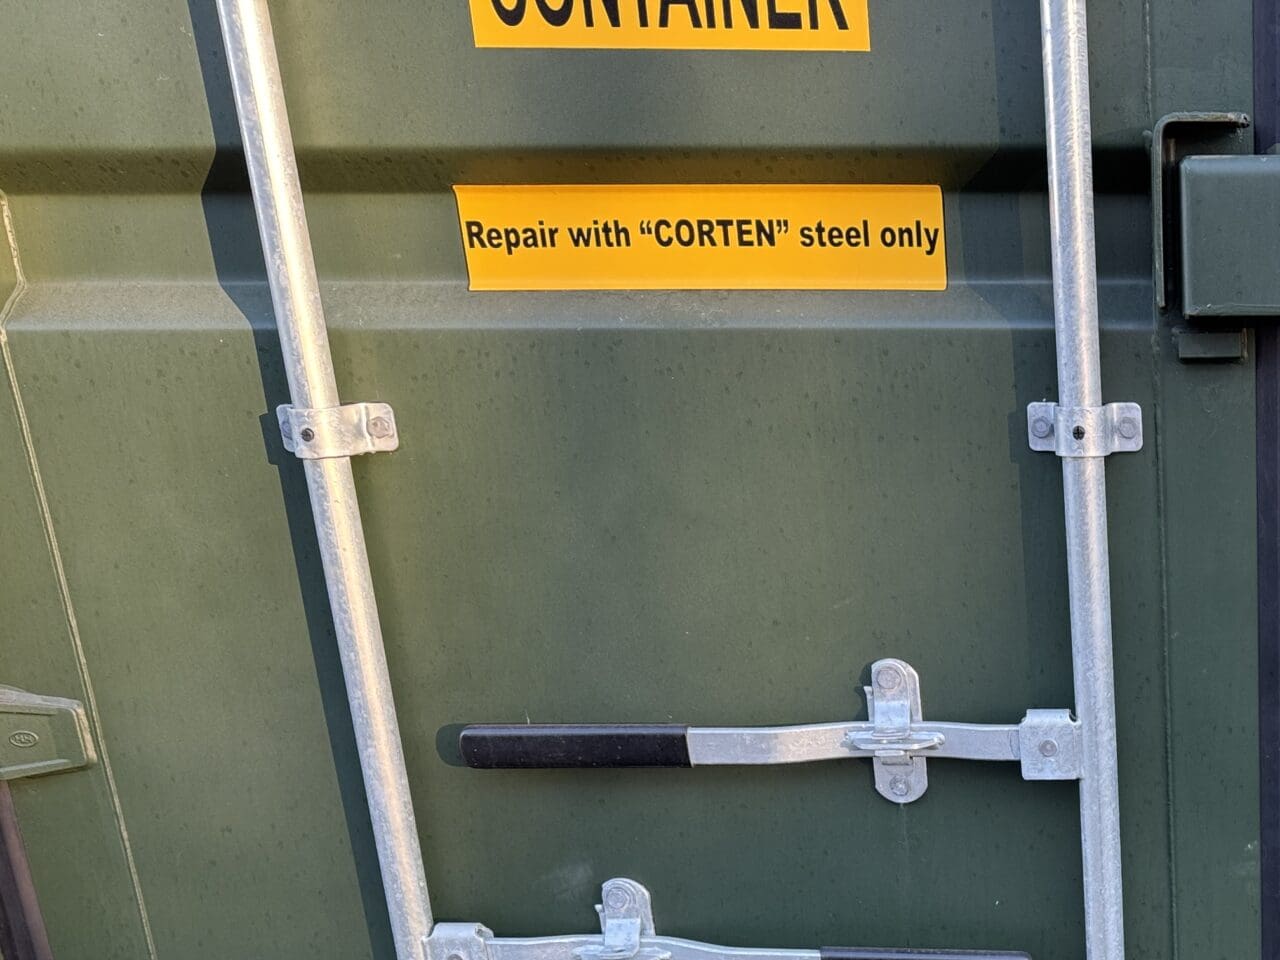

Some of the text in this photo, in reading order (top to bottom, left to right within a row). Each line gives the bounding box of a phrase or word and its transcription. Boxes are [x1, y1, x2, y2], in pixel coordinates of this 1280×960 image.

[465, 218, 939, 256] Repair with “CORTEN” steel only
